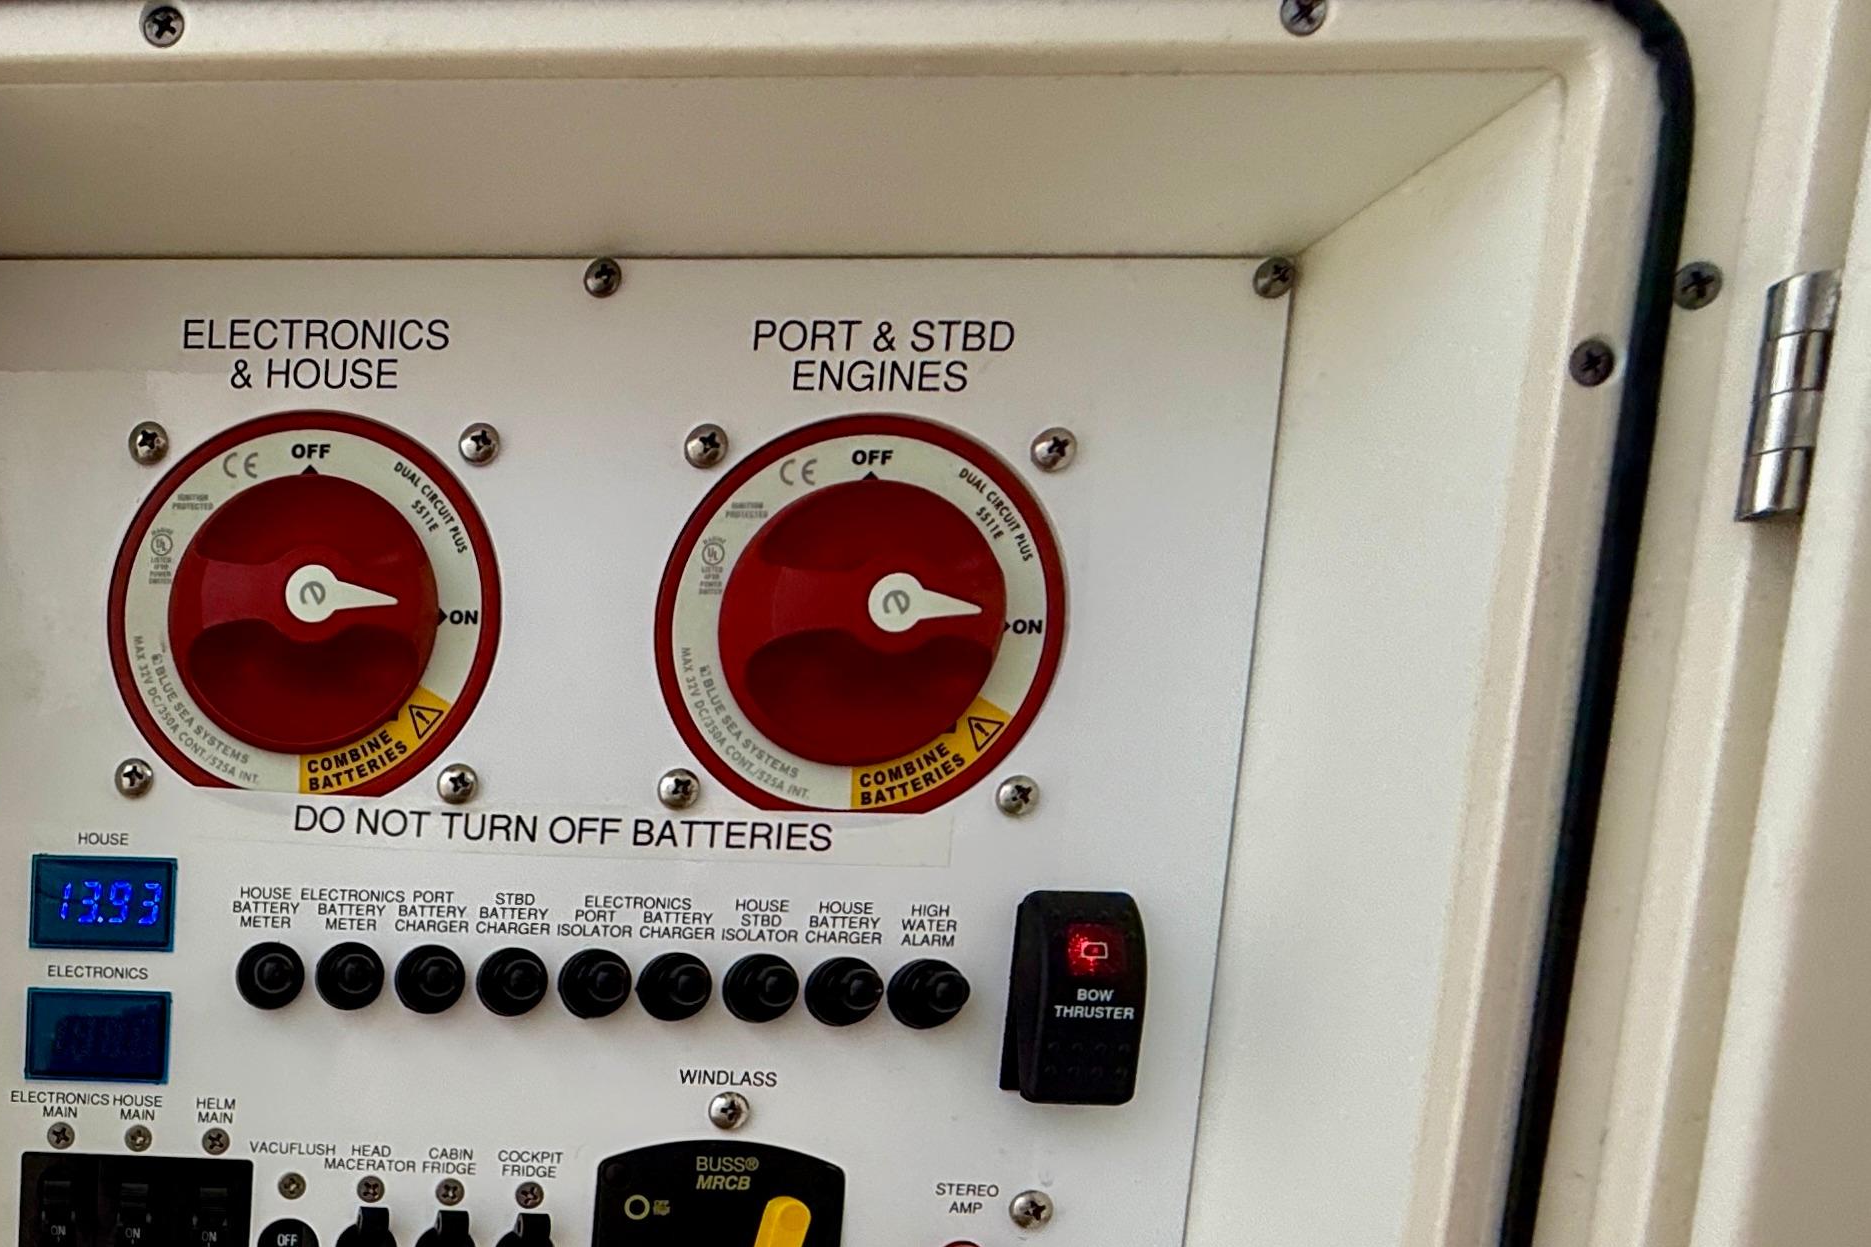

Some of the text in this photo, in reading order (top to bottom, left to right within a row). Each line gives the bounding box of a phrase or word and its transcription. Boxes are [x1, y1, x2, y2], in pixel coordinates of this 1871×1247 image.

[183, 319, 450, 350] ELECTRONICS
[753, 320, 1015, 352] PORT & STBD
[231, 359, 398, 389] & HOUSE
[792, 360, 968, 392] ENGINES
[291, 444, 330, 460] OFF
[852, 450, 893, 465] OFF
[394, 461, 468, 553] DUAL CIRCUIT PLUS
[411, 500, 439, 533] 5511E
[959, 468, 1033, 562] DUAL CIRCUIT PLUS
[975, 506, 1004, 540] 5511E
[450, 610, 478, 625] ON
[1012, 619, 1042, 633] ON
[155, 666, 250, 763] BLUE SEA SYSTEMS
[703, 678, 799, 778] BLUE SEA SYSTEMS
[307, 730, 392, 773] COMBINE
[309, 740, 407, 791] BATTERIES
[860, 743, 950, 787] COMBINE
[860, 753, 965, 805] BATTERIES
[294, 805, 832, 851] DO NOT TURN OFF BATTERIES
[78, 832, 129, 845] HOUSE
[240, 887, 292, 899] HOUSE
[301, 888, 404, 903] ELECTRONICS
[414, 891, 454, 903] PORT
[496, 893, 535, 906] STBD
[59, 881, 162, 924] 13.93
[233, 902, 299, 914] BATTERY
[585, 895, 692, 910] ELECTRONICS
[736, 899, 789, 912] HOUSE
[819, 901, 873, 914] HOUSE
[398, 905, 466, 918] BATTERY
[575, 910, 615, 922] PORT
[912, 904, 949, 917] HIGH
[240, 916, 291, 928] METER
[644, 912, 713, 925] BATTERY
[741, 914, 781, 926] STBD
[902, 919, 956, 932] WATER
[395, 919, 469, 933] CHARGER
[558, 924, 632, 938] ISOLATOR
[640, 926, 714, 940] CHARGER
[722, 929, 798, 942] ISOLATOR
[901, 934, 954, 947] ALARM
[48, 966, 148, 980] ELECTRONICS
[1077, 989, 1114, 1001] BOW
[1054, 1005, 1134, 1020] THRUSTER
[679, 1070, 777, 1088] WINDLASS
[11, 1091, 110, 1105] ELECTRONICS
[113, 1095, 163, 1108] HOUSE
[196, 1098, 235, 1110] HELM
[43, 1106, 77, 1118] MAIN
[198, 1112, 233, 1124] MAIN
[250, 1141, 336, 1156] VACUFLUSH
[351, 1145, 391, 1157] HEAD
[429, 1148, 473, 1161] CABIN
[498, 1151, 564, 1163] COCKPIT
[324, 1158, 416, 1172] MACERATOR
[423, 1161, 476, 1175] FRIDGE
[502, 1164, 556, 1178] FRIDGE
[696, 1175, 750, 1191] MRCB
[936, 1183, 999, 1198] STEREO
[950, 1201, 982, 1214] AMP
[277, 1235, 297, 1247] OFF
